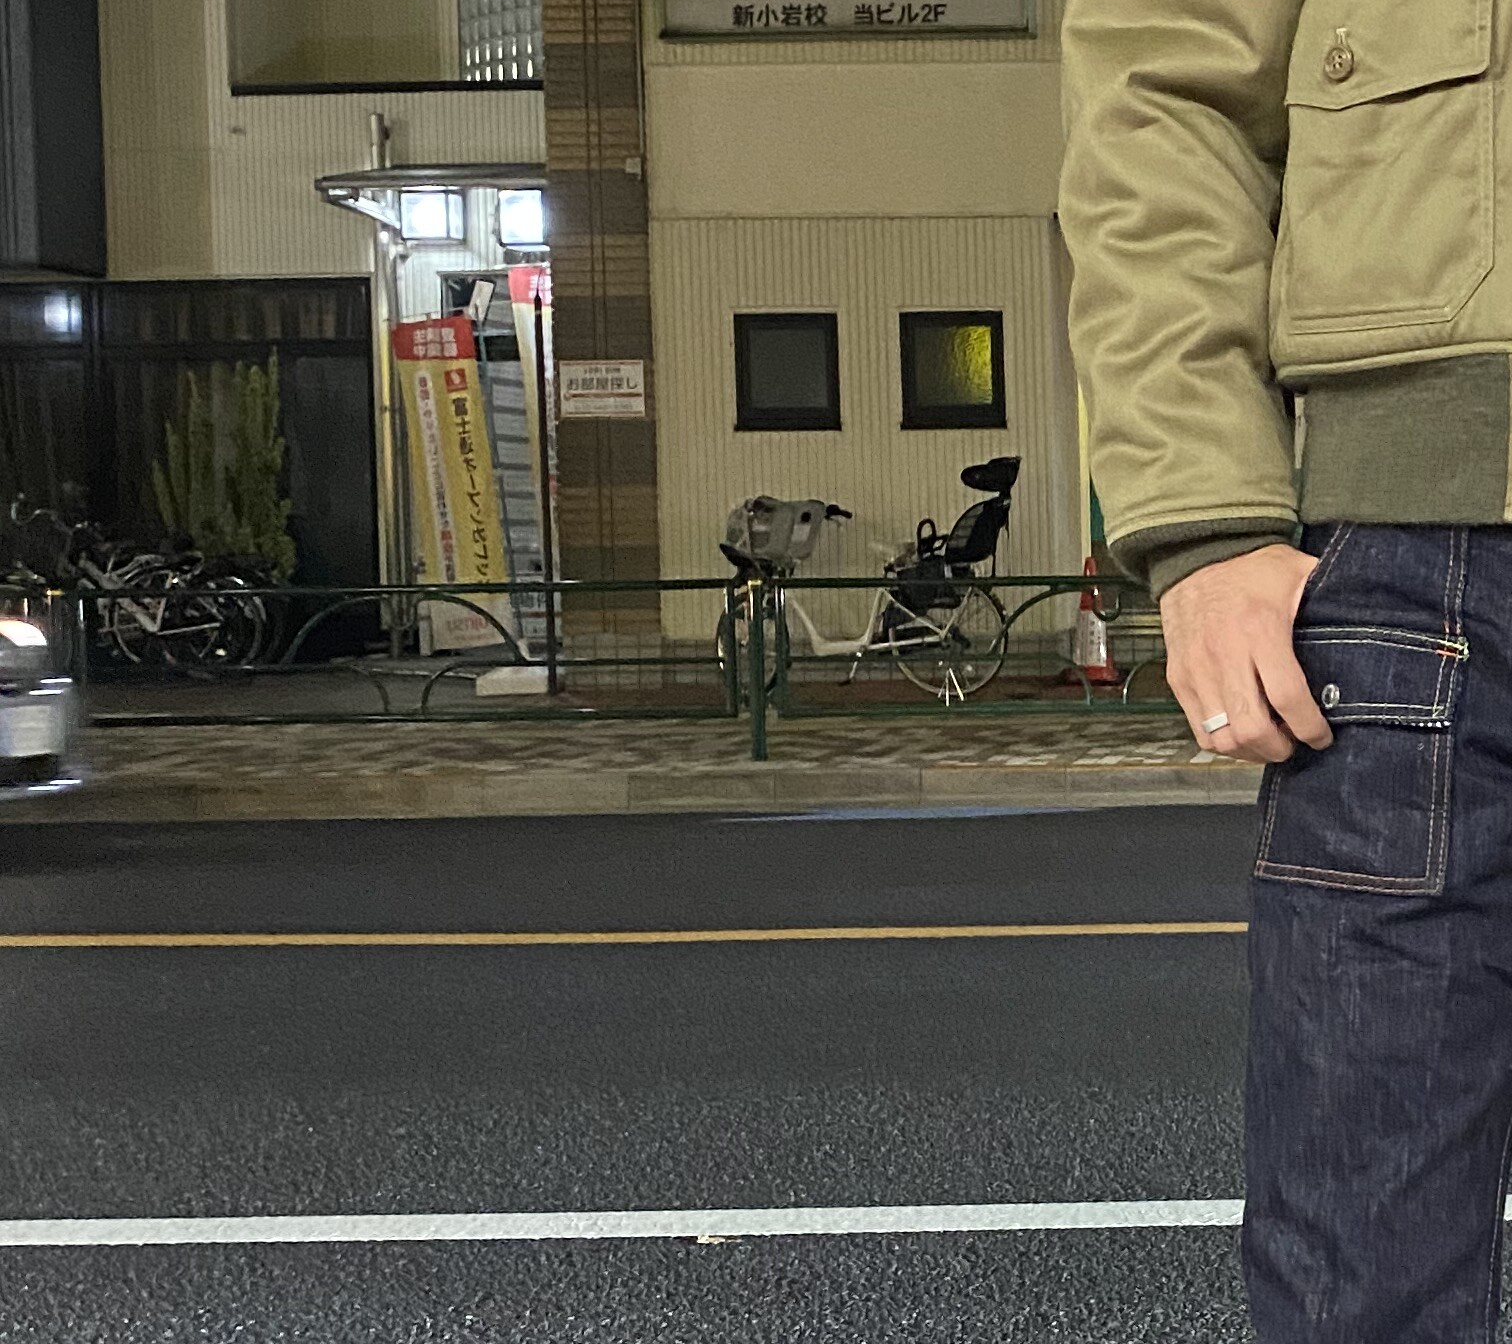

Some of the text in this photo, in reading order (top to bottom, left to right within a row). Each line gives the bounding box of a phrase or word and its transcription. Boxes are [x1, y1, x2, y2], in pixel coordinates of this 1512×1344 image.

[733, 3, 948, 28] 新小岩校 当ビル2F
